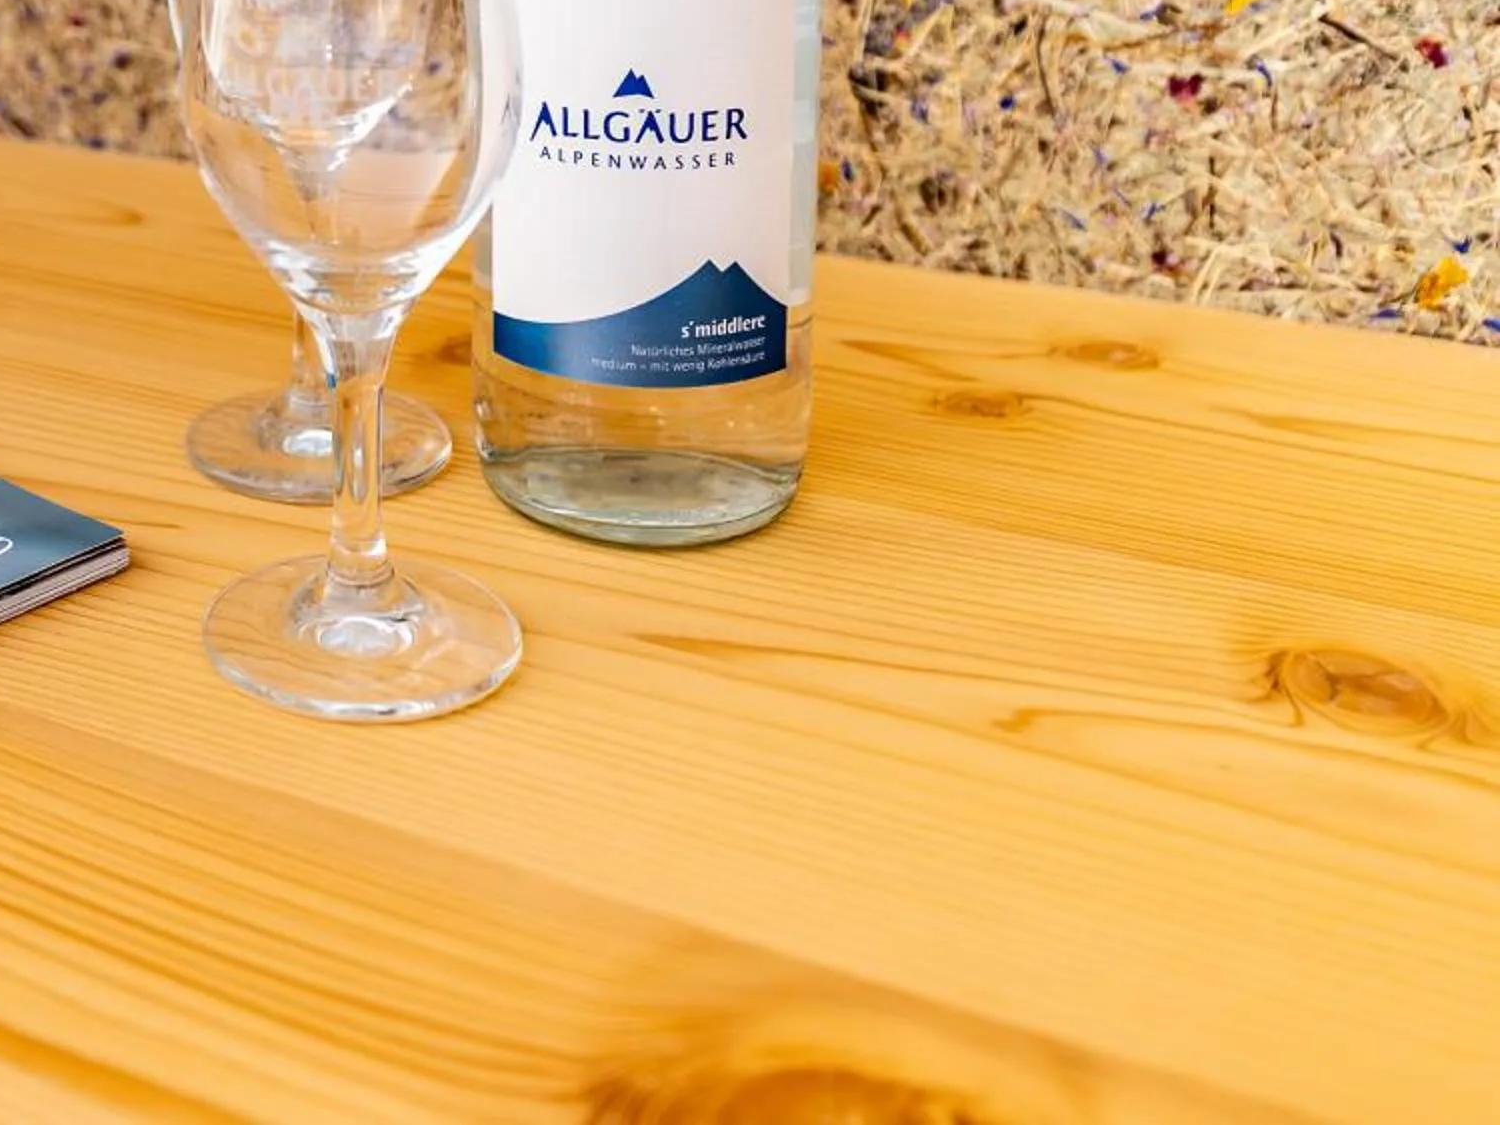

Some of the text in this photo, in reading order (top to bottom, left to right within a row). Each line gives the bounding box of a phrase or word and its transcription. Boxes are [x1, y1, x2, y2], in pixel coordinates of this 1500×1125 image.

[530, 101, 748, 144] ALLGÄUER
[540, 146, 737, 171] ALPENWASSER
[631, 343, 694, 357] Natürliches
[650, 359, 670, 371] mit
[673, 358, 706, 372] wenig
